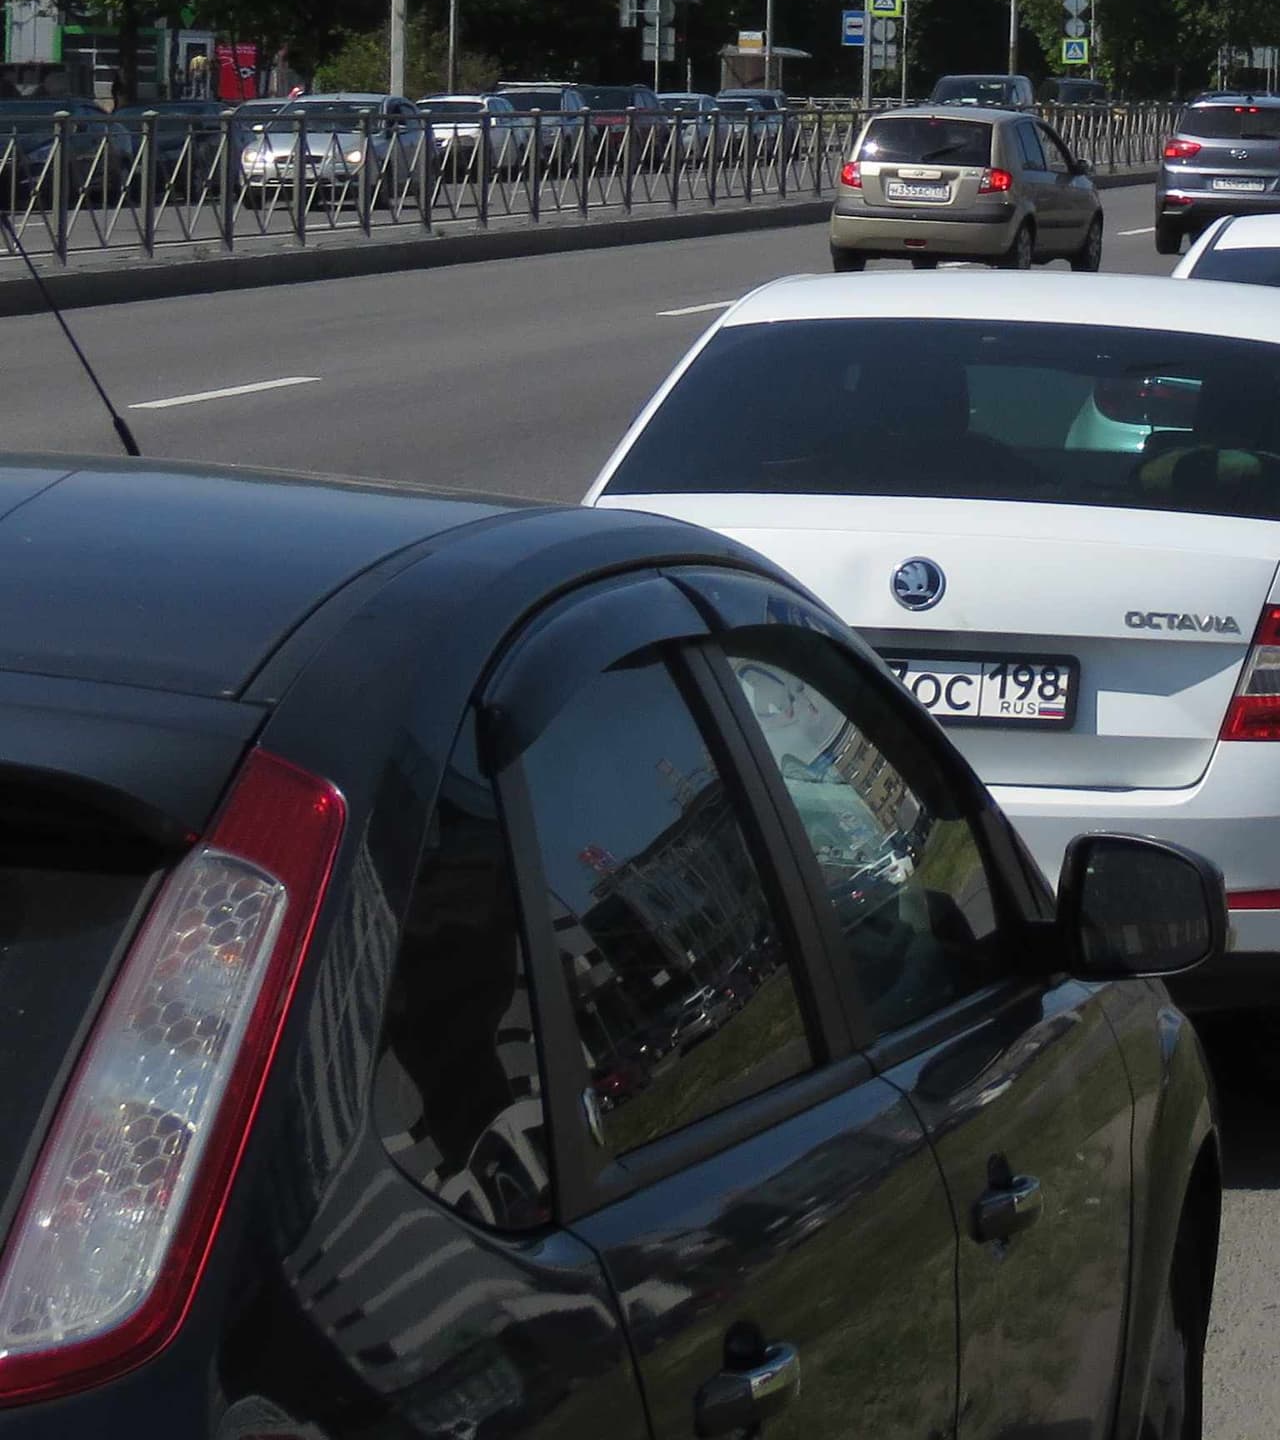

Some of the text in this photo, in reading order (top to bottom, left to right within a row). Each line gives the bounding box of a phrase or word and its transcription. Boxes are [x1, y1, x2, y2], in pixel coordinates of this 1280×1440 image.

[1124, 611, 1242, 635] OCTAVIA
[988, 661, 1061, 702] 198
[1000, 701, 1037, 715] RUS
